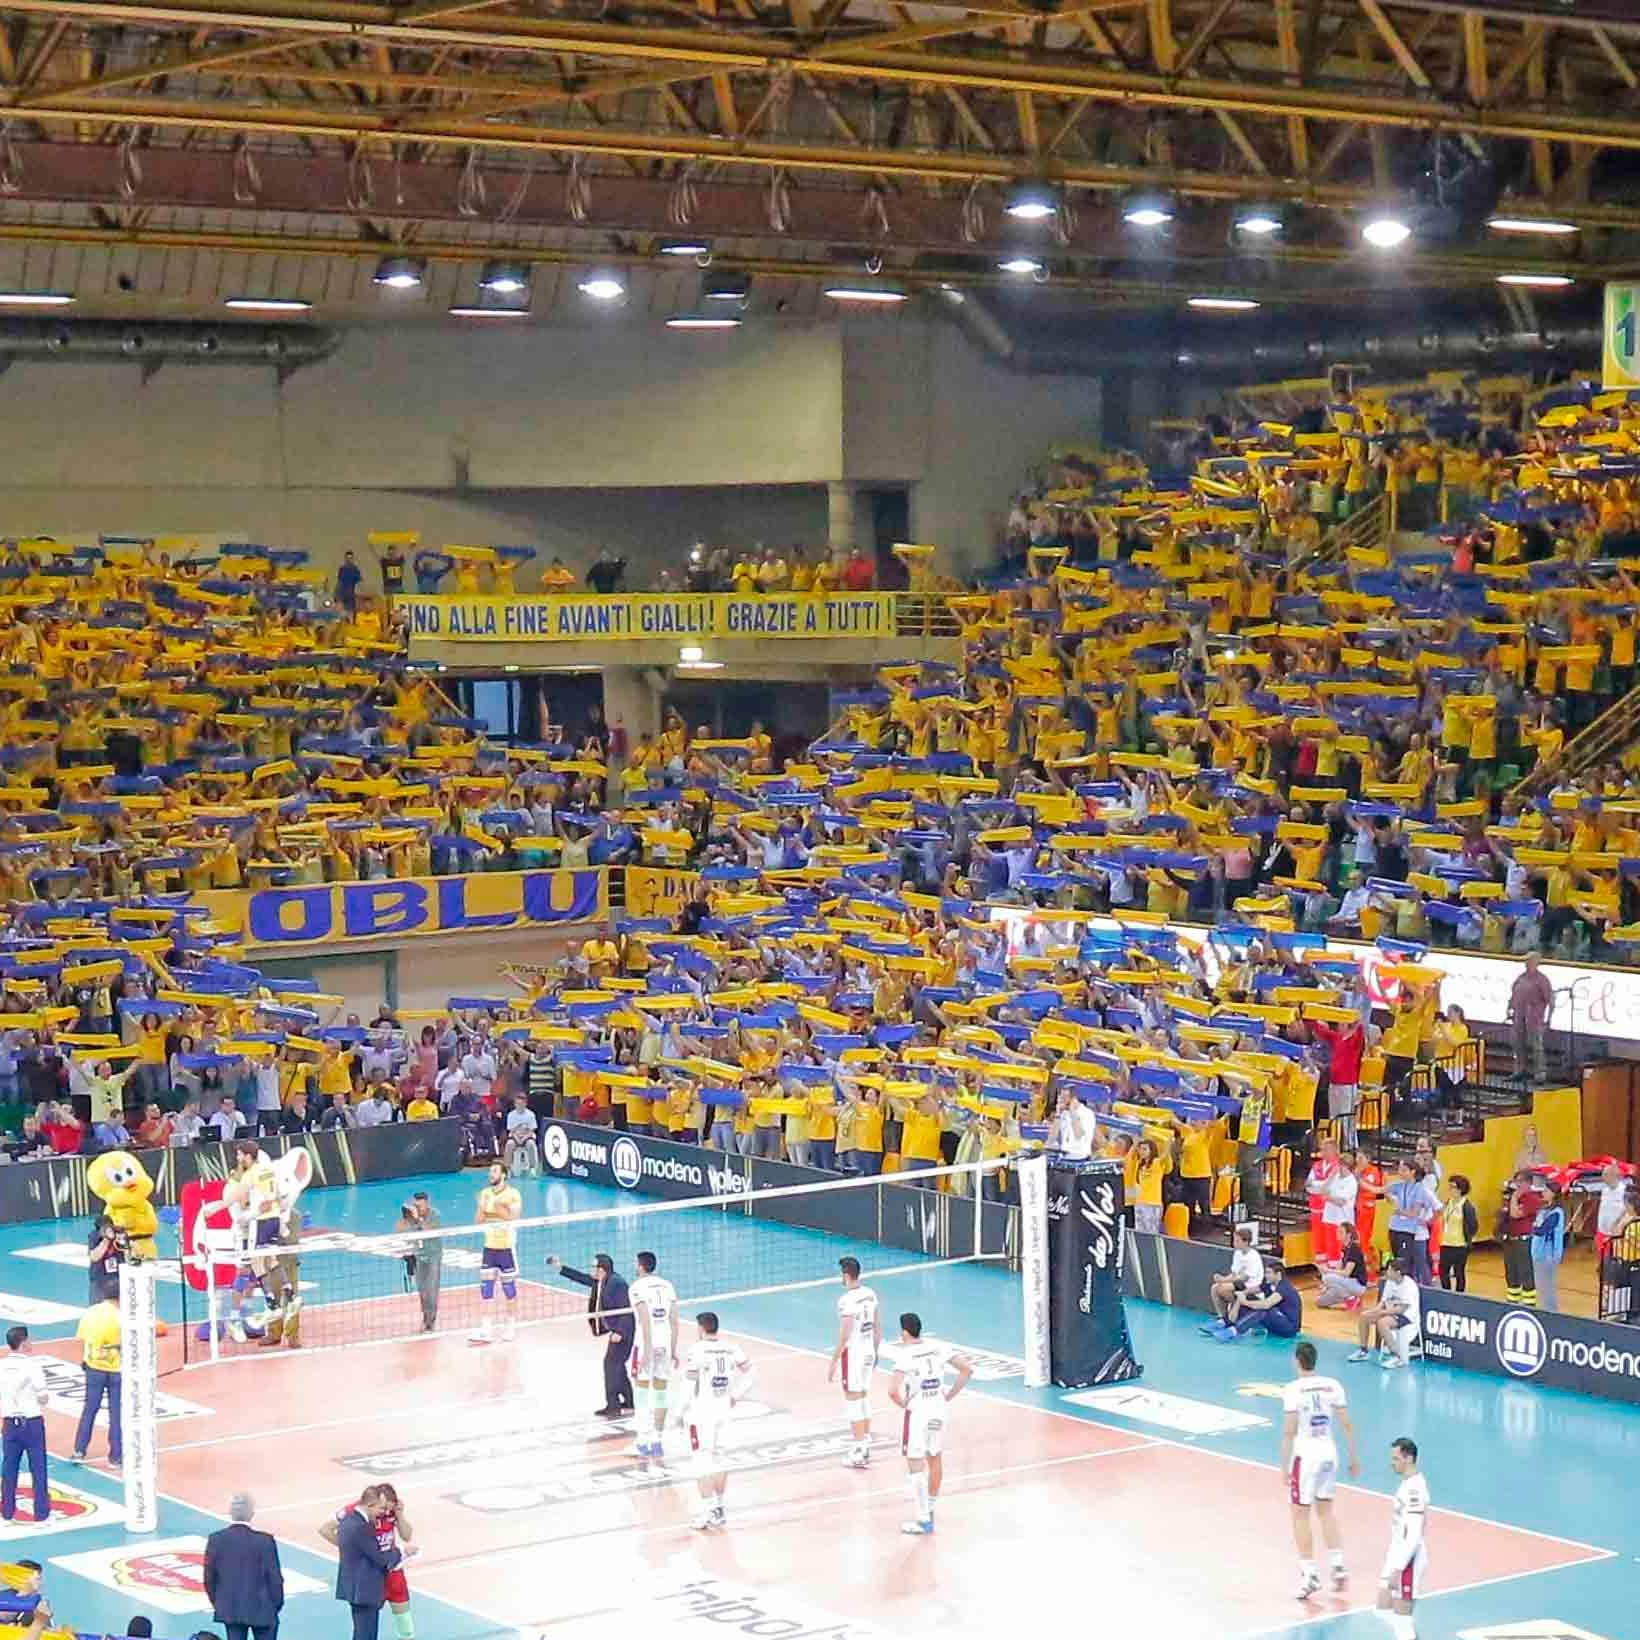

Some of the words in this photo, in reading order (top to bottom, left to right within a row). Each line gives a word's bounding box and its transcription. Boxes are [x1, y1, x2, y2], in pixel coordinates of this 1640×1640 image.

[448, 604, 496, 635] ALLA
[504, 604, 549, 634] FINE
[559, 603, 632, 634] AVANTI
[640, 602, 715, 634] GIALLI!
[727, 601, 798, 633] GRAZIE
[804, 602, 817, 632] A
[249, 870, 601, 943] OBLU
[570, 1139, 608, 1166] OXFAM
[642, 1156, 703, 1186] modena
[1425, 1309, 1486, 1345] OXFAM
[1424, 1339, 1453, 1359] Italia
